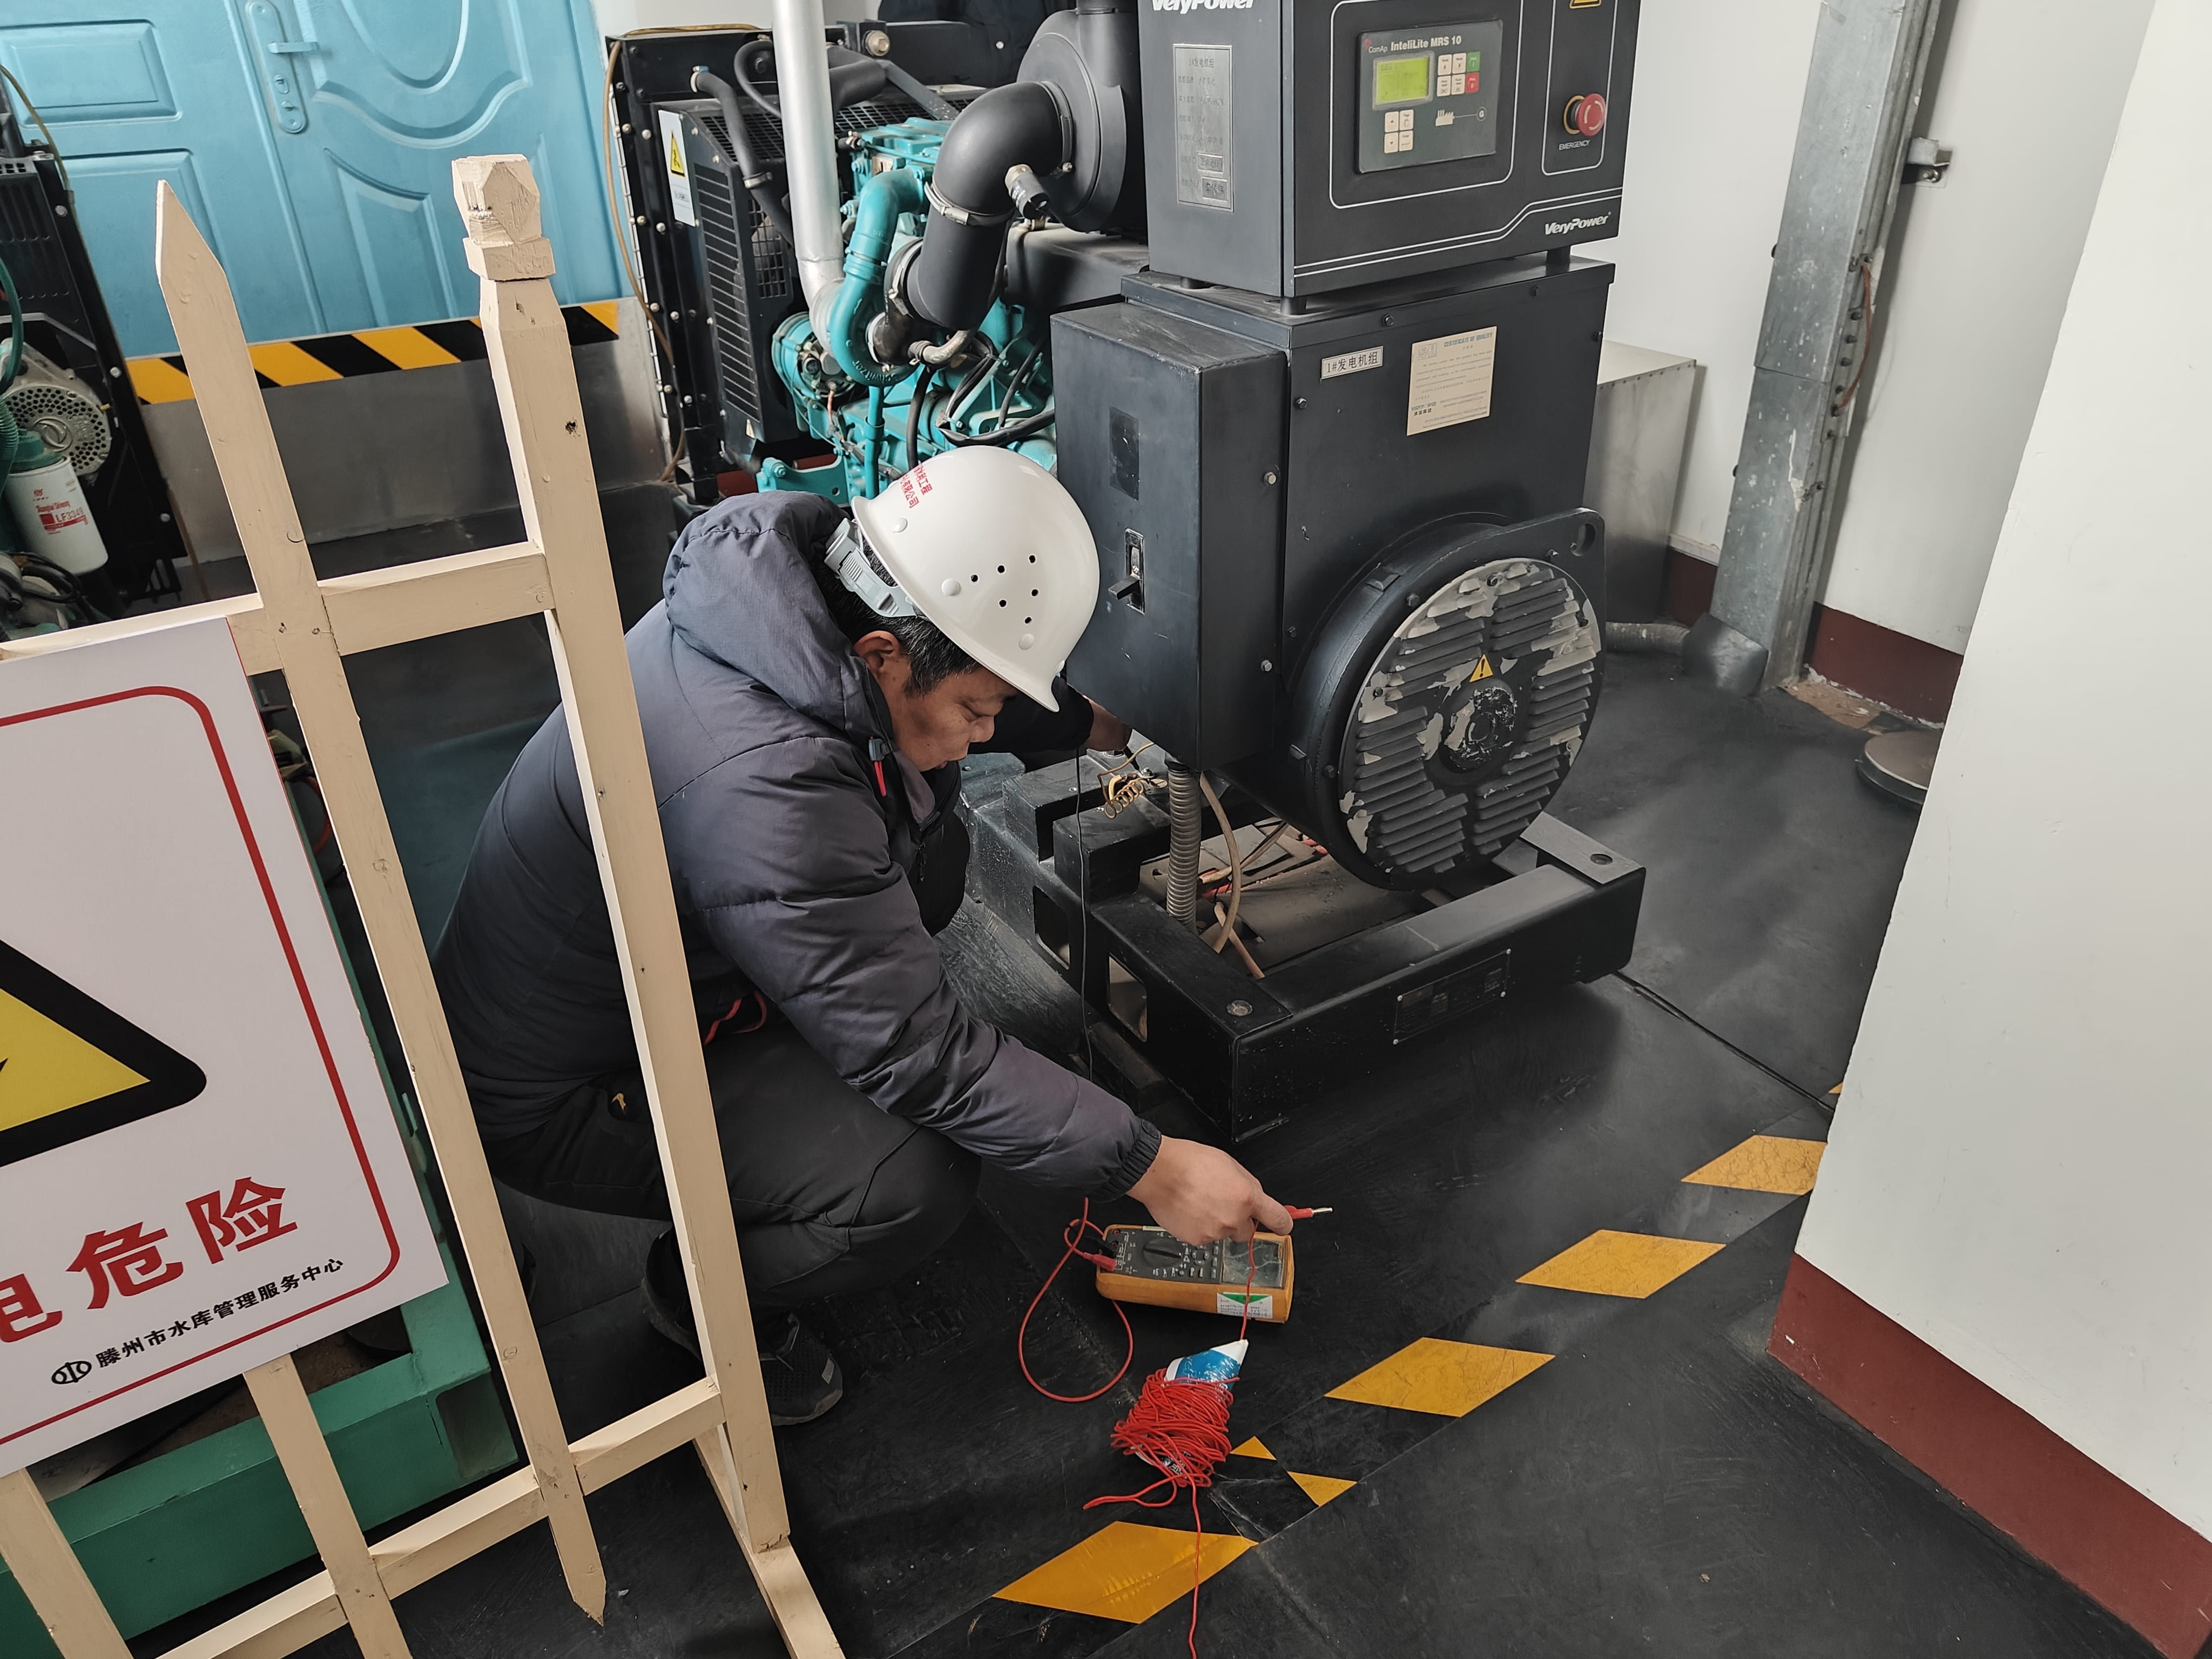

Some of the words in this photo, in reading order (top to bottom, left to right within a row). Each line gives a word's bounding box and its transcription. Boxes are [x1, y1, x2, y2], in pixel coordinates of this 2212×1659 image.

[1368, 45, 1388, 53] ComAp
[1391, 38, 1428, 51] InteliLite
[1431, 36, 1449, 47] MRS
[1452, 35, 1462, 45] 10
[1559, 140, 1590, 150] EMERGENCY
[1545, 215, 1609, 235] VeryPower
[1327, 351, 1378, 373] 1#发电机组
[95, 1258, 344, 1368] 滕州市水库管理服务中心
